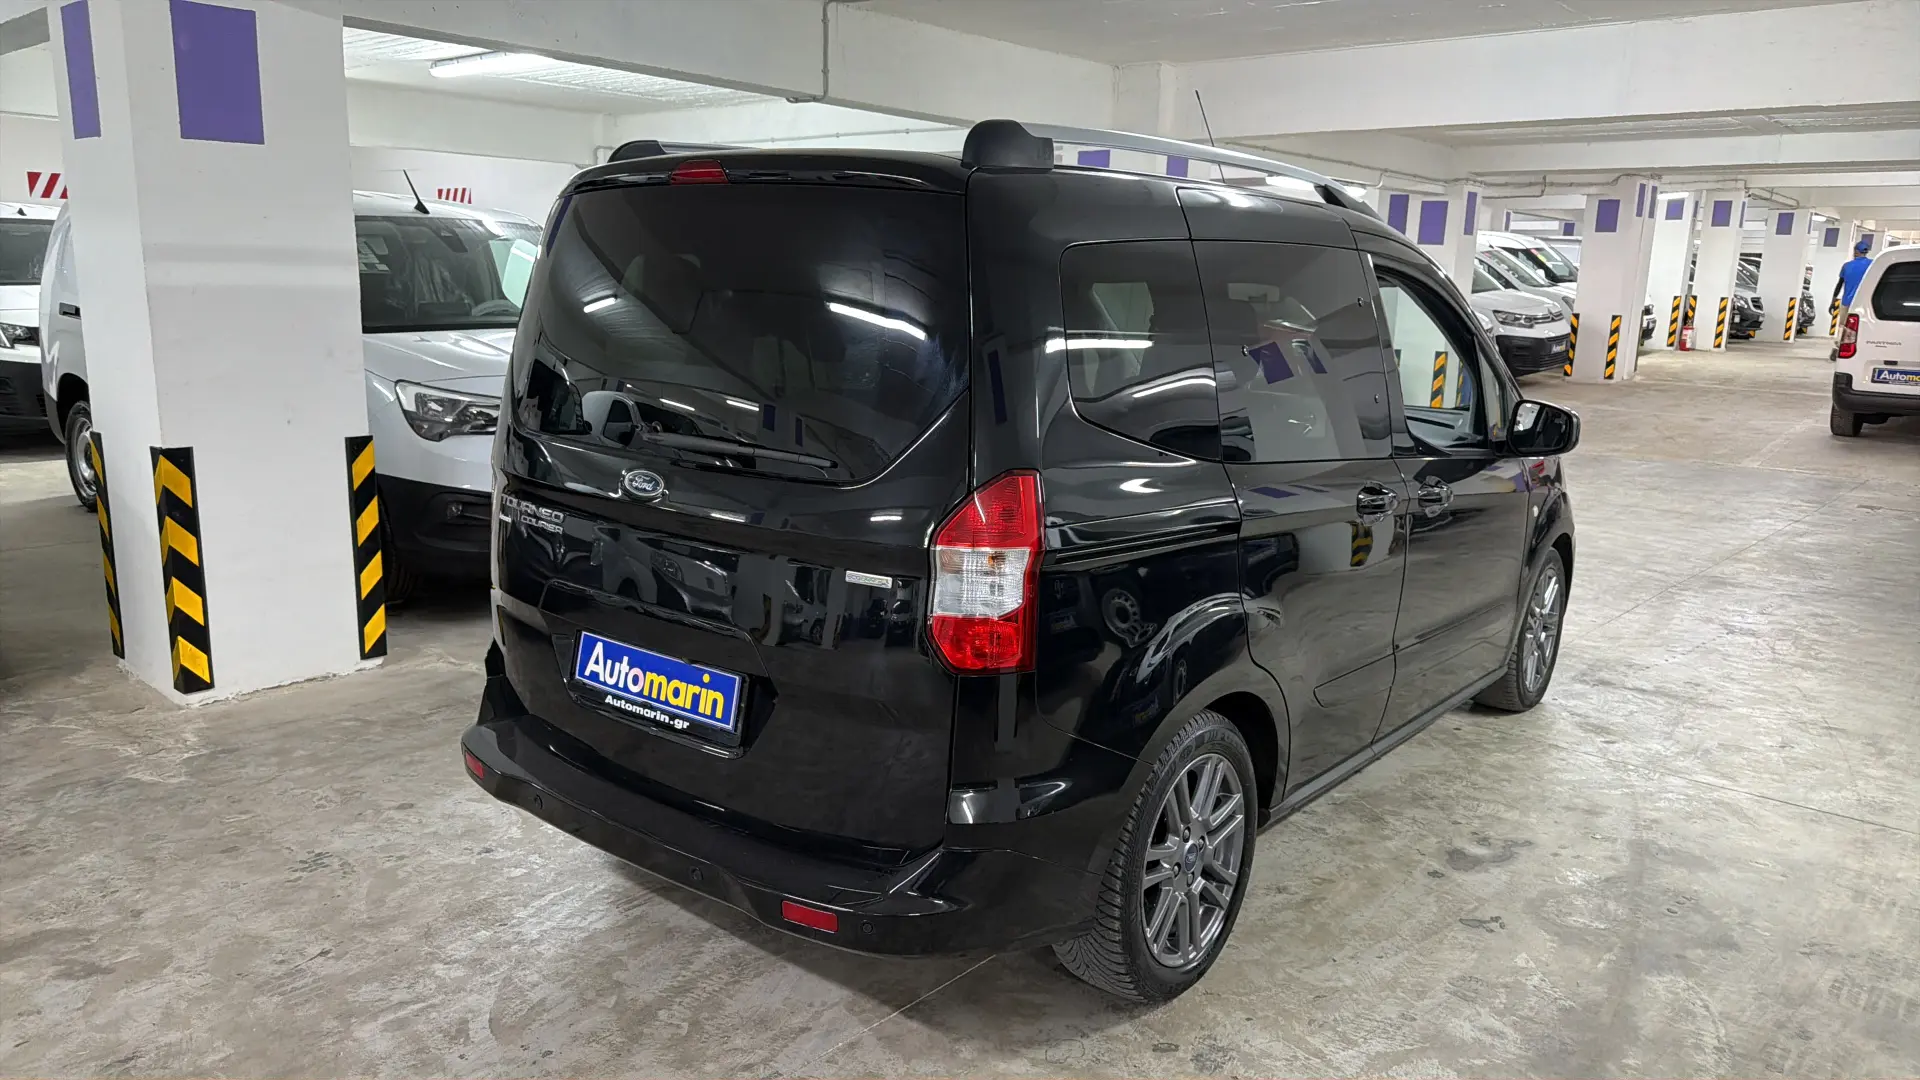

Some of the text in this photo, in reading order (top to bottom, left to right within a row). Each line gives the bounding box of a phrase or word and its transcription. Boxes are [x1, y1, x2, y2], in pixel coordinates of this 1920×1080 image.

[631, 474, 656, 491] Ford
[502, 493, 564, 524] TOURNEO
[520, 514, 564, 535] COURIER
[583, 641, 725, 720] Automarin
[604, 694, 690, 730] Automarin.gr
